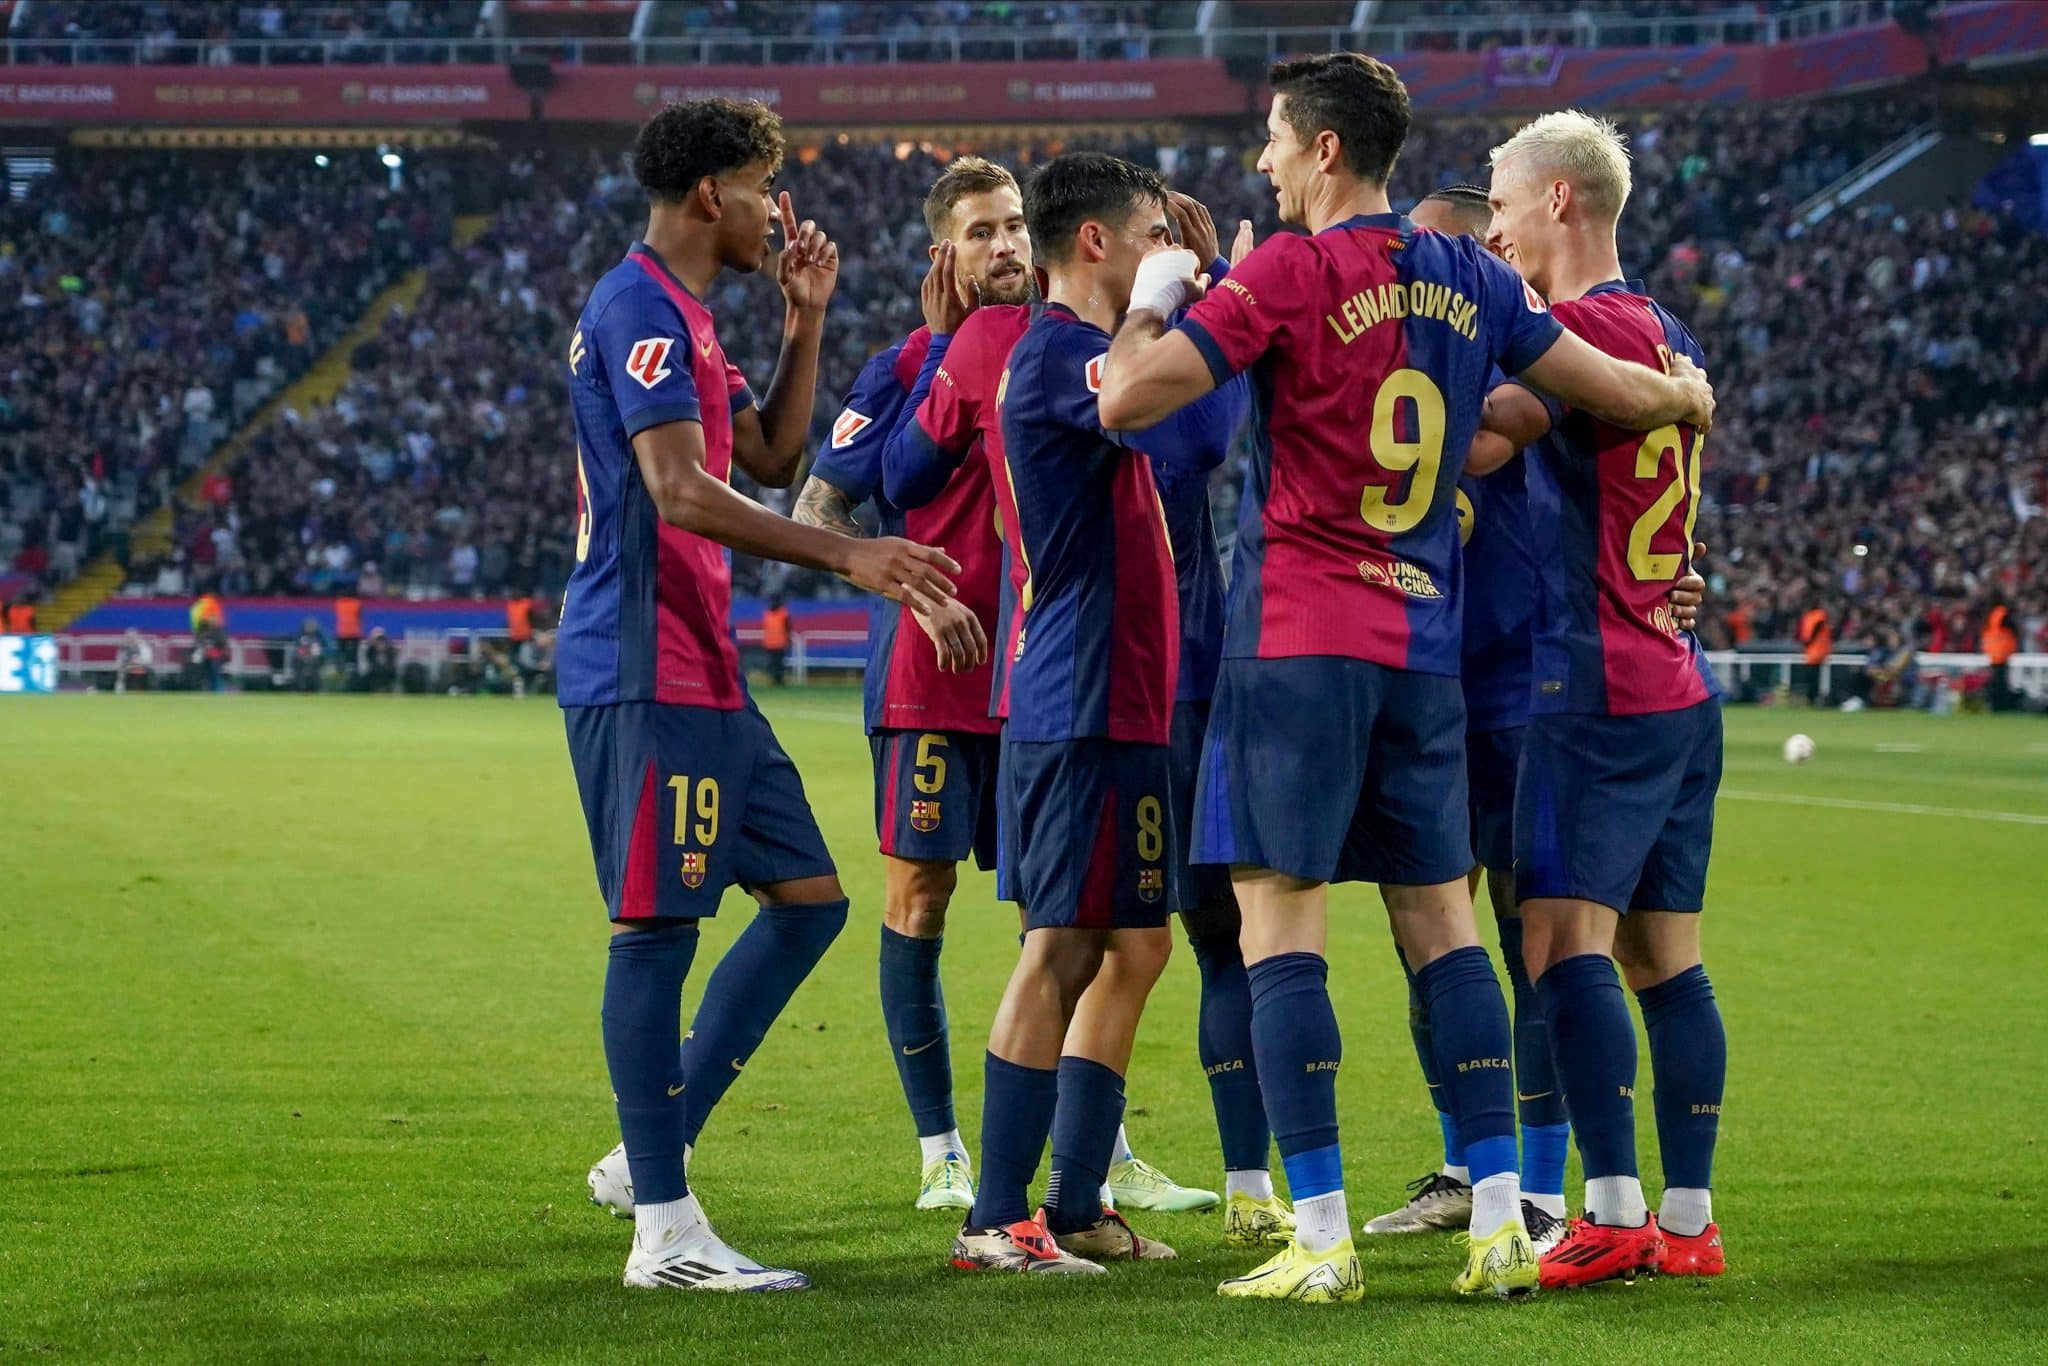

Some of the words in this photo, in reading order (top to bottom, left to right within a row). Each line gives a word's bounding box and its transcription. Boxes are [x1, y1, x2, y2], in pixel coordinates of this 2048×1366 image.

[1360, 368, 1446, 533] 9
[913, 733, 949, 794] 5
[667, 775, 720, 847] 19
[1136, 795, 1163, 861] 8
